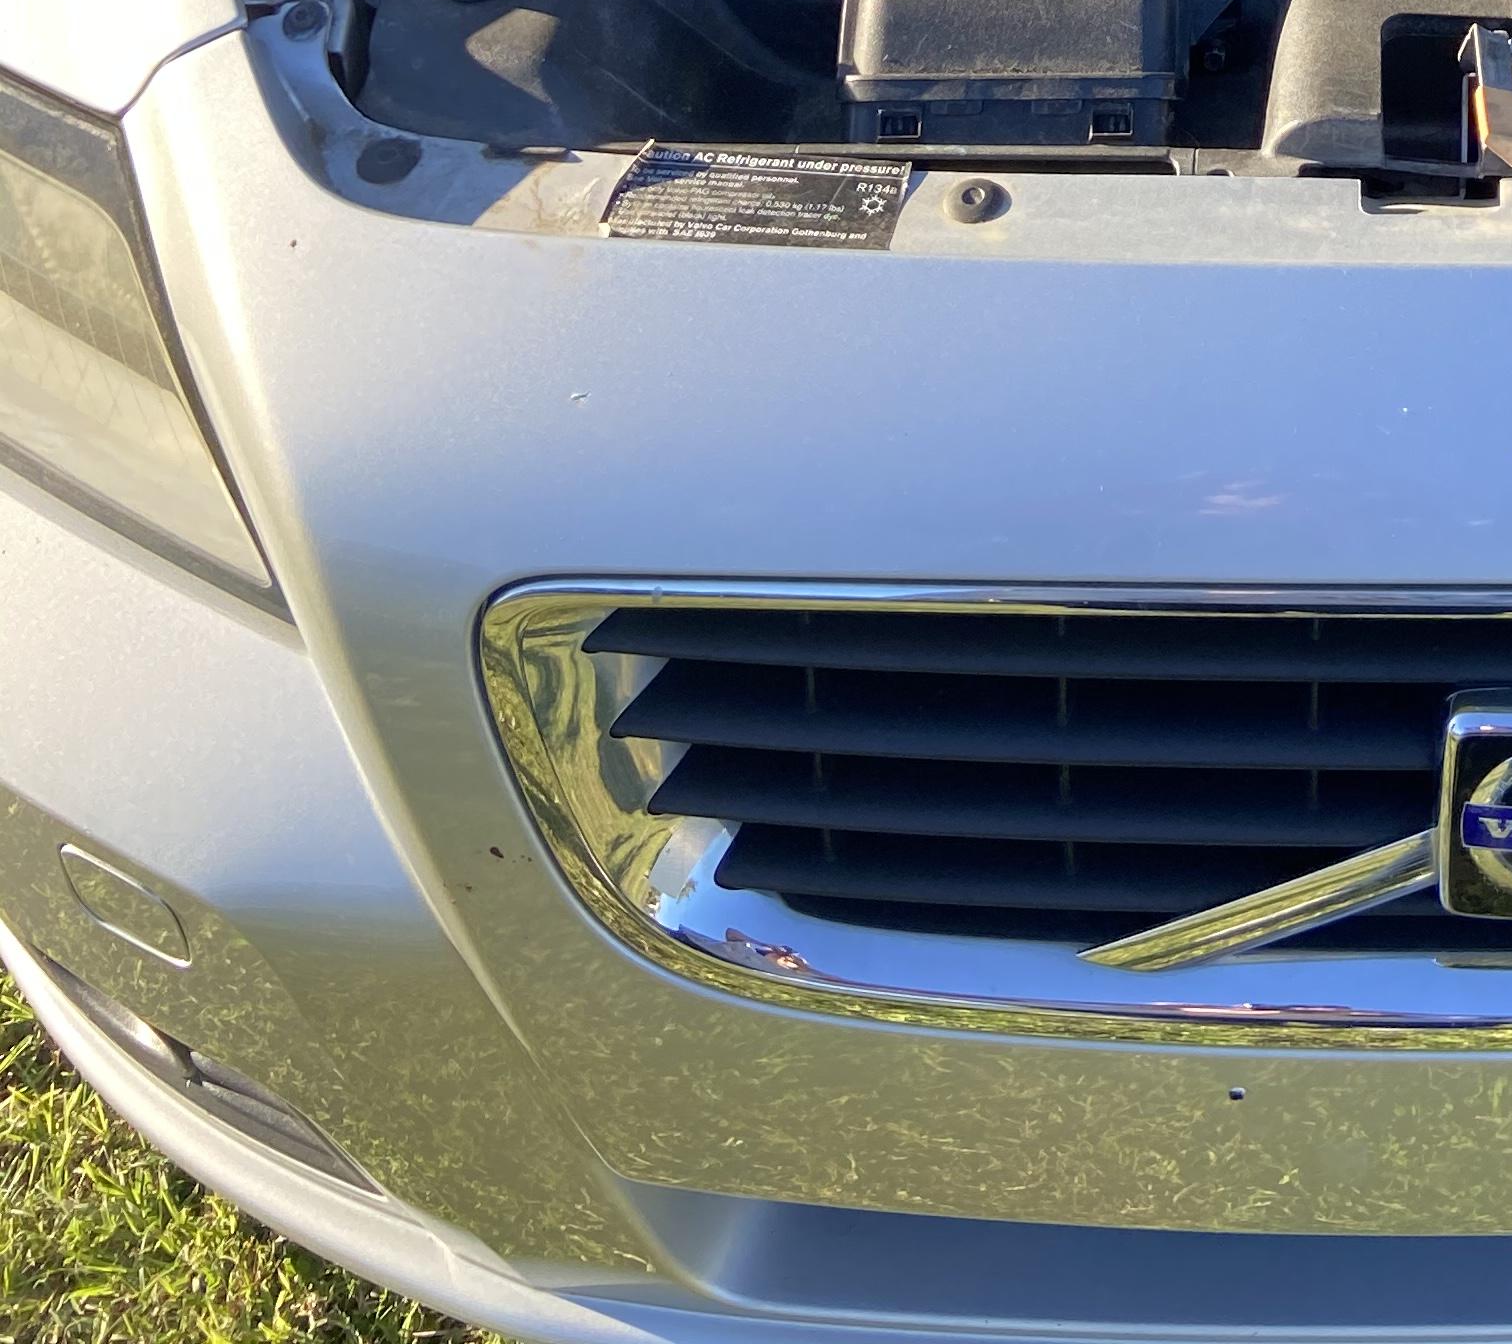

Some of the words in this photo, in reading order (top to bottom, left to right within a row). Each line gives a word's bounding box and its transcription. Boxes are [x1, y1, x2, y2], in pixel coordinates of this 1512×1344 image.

[693, 152, 715, 163] AC
[717, 153, 795, 169] Refrigerant
[797, 158, 839, 171] under
[839, 162, 905, 176] pressure!
[687, 221, 713, 230] Volvo
[734, 224, 790, 234] Corporation
[792, 228, 847, 240] Gothenburg
